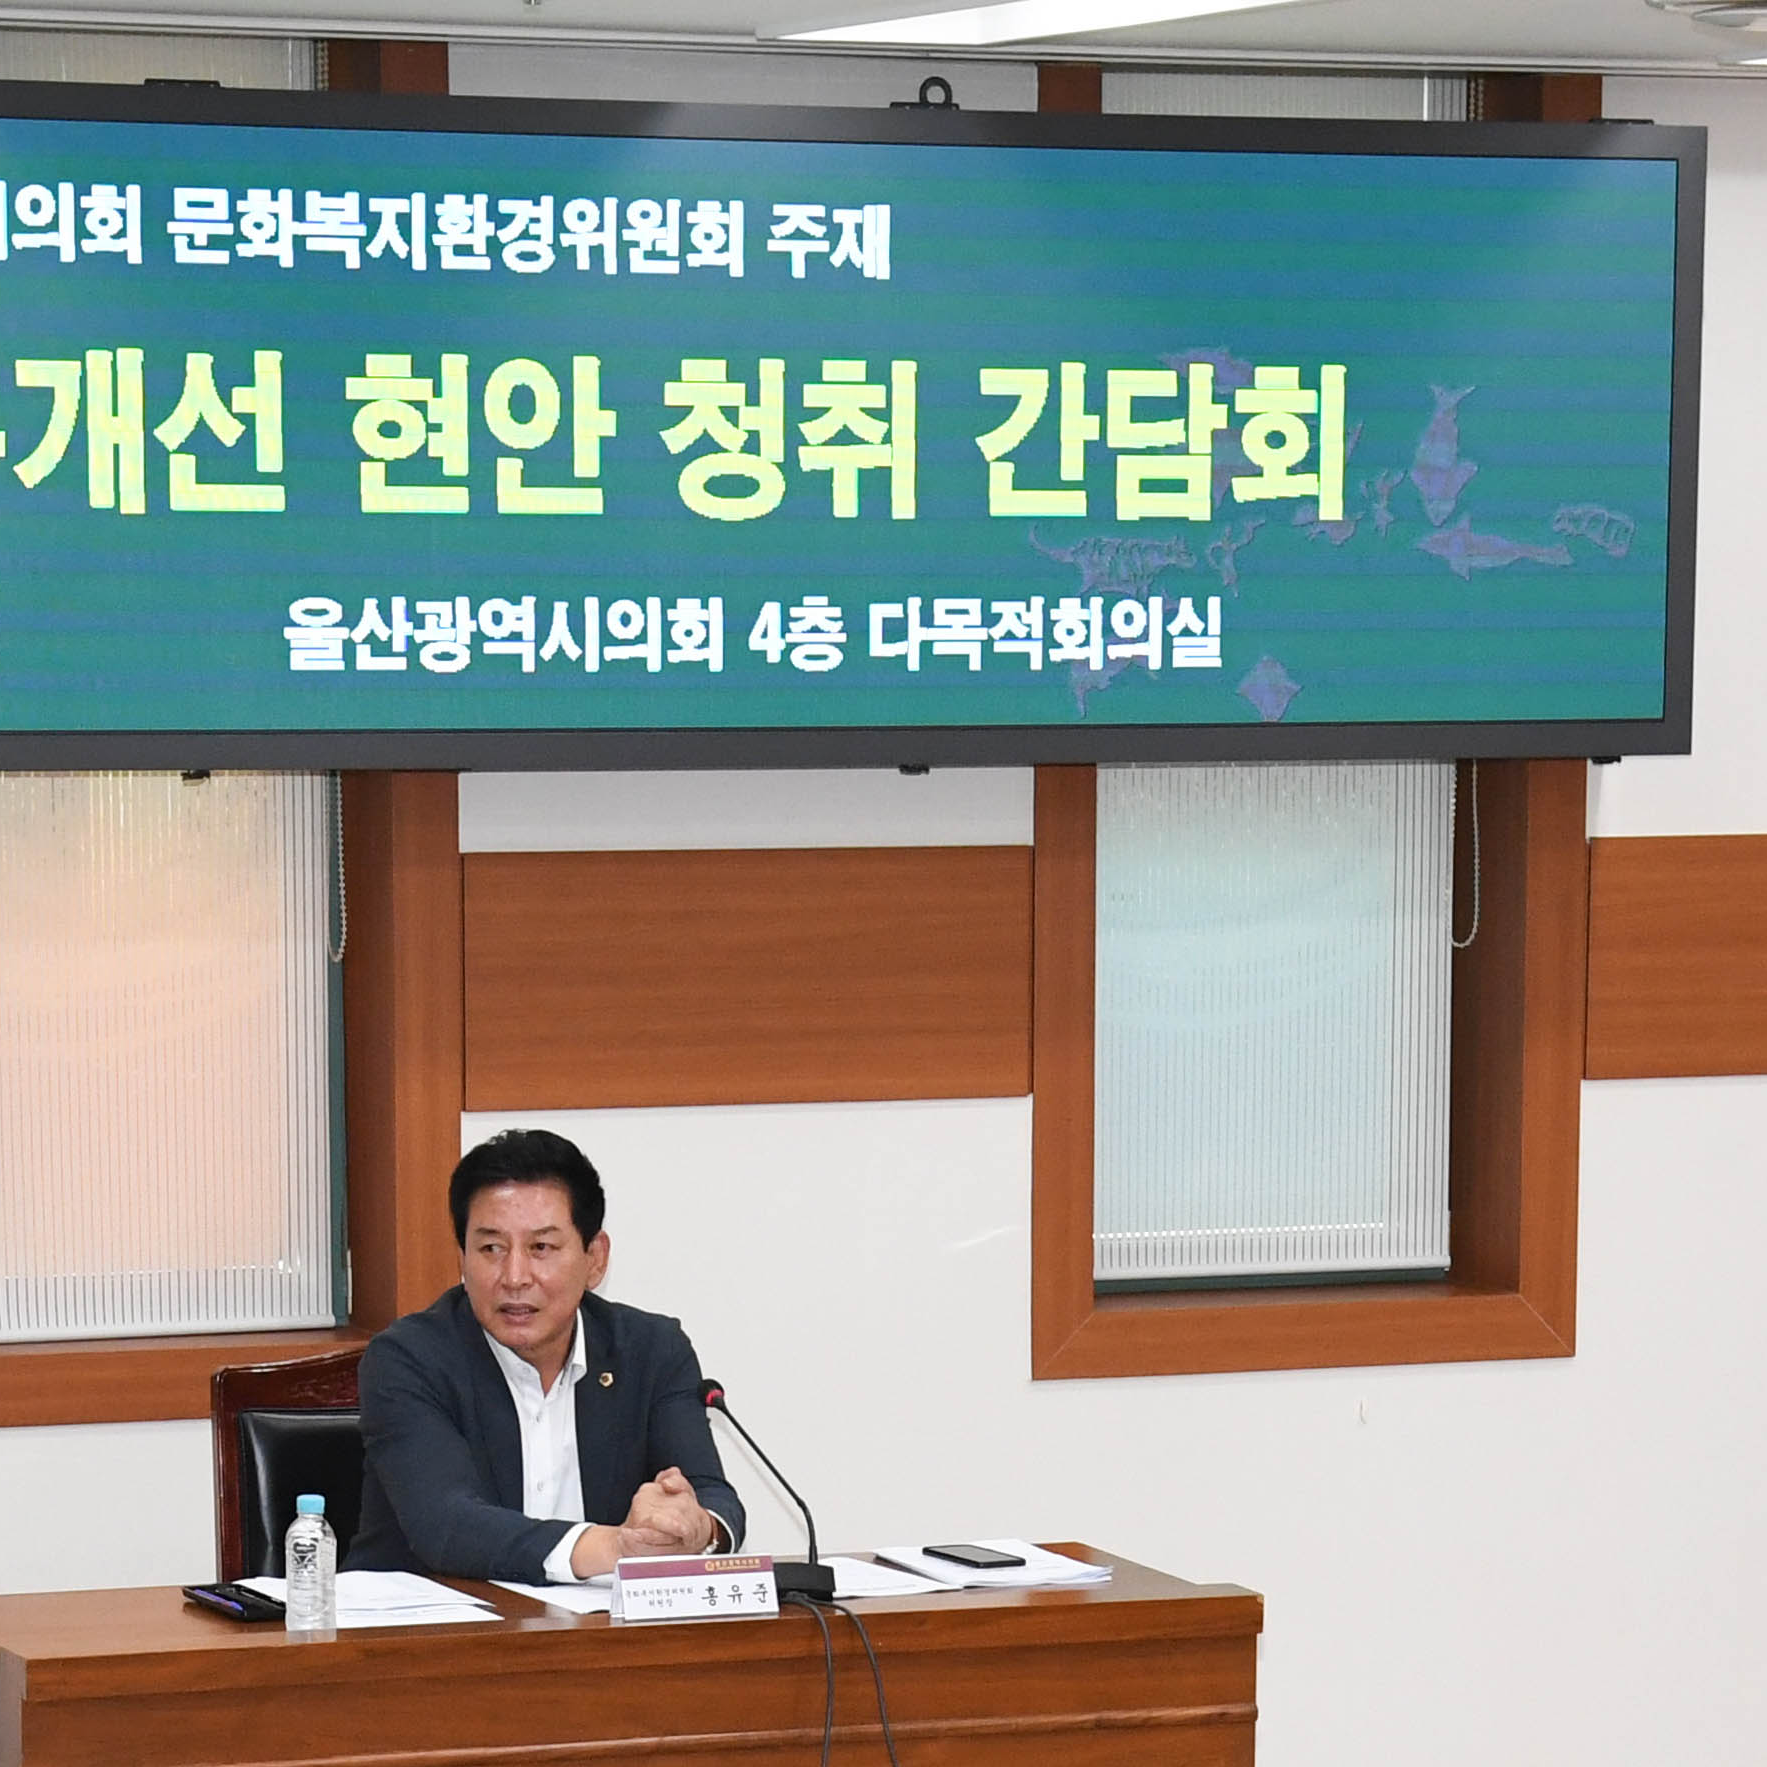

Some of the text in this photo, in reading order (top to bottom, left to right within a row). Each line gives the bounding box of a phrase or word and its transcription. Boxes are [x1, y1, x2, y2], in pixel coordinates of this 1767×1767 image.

[166, 187, 745, 278] 문화복지환경위원회
[767, 203, 892, 281] 주재
[345, 353, 617, 514] 현안
[659, 358, 917, 521] 청취
[975, 362, 1348, 522] 간담회
[283, 596, 1222, 673] 울산광역시의회 4층 다목적회의실
